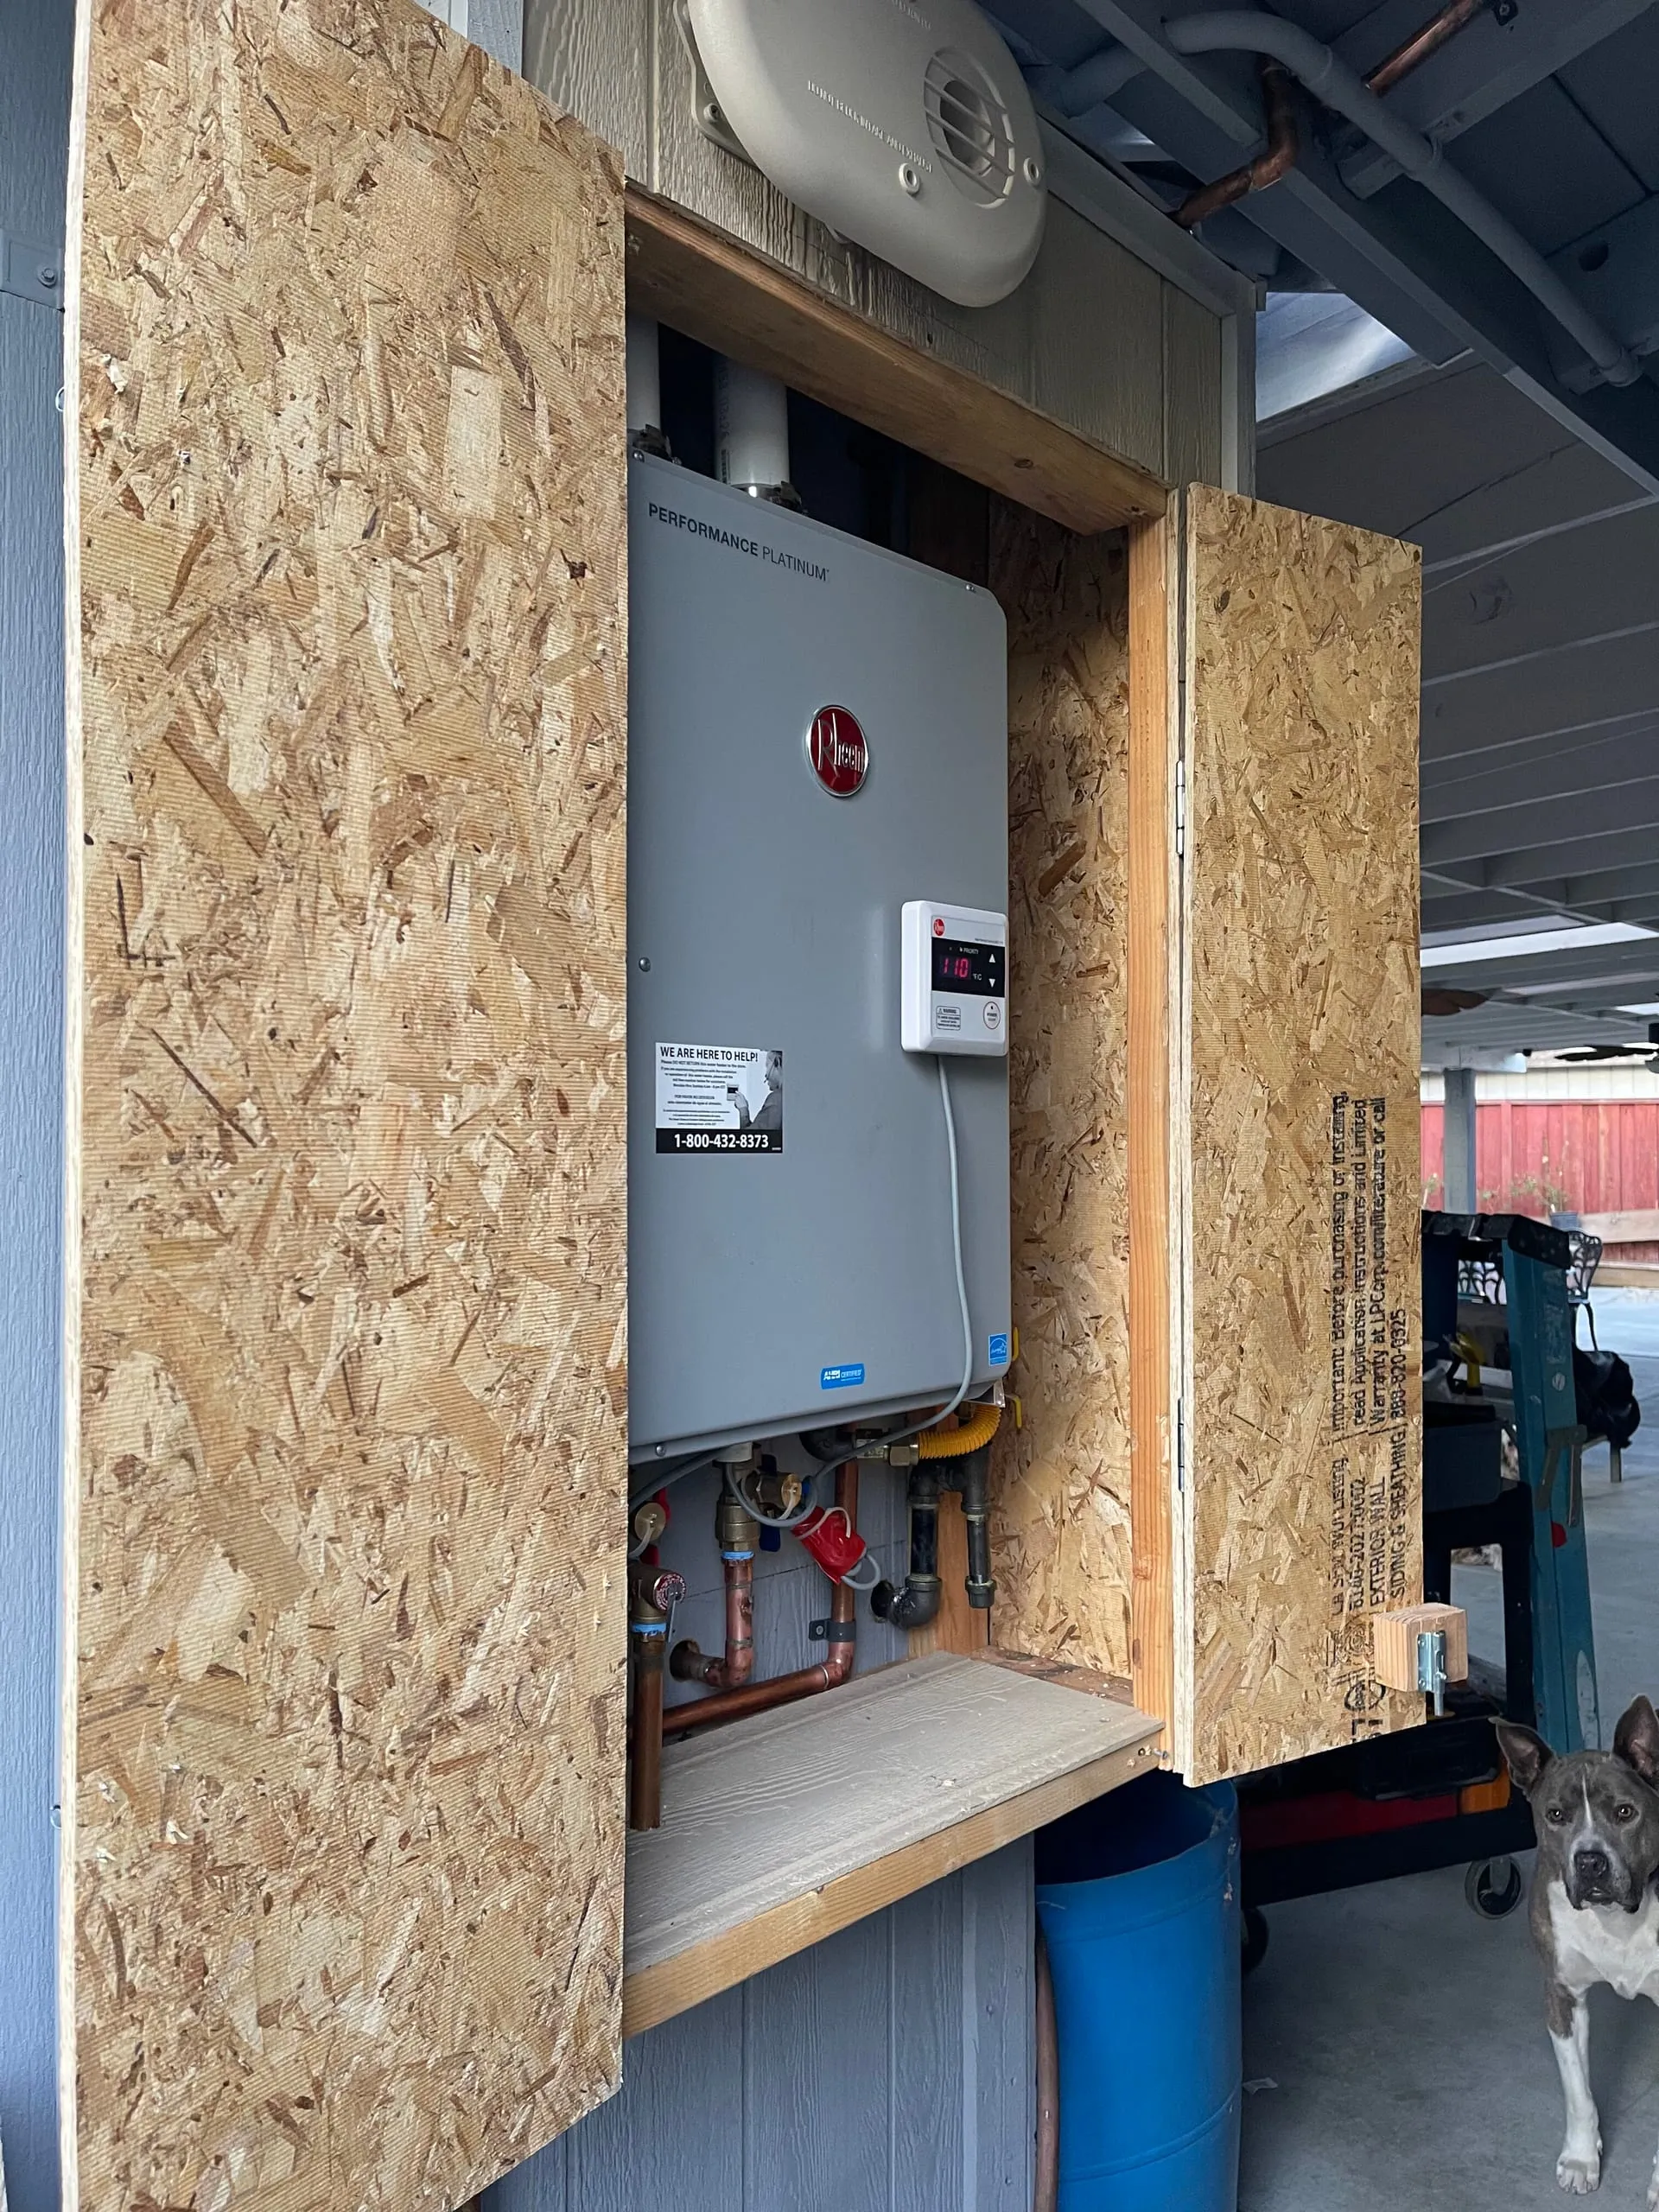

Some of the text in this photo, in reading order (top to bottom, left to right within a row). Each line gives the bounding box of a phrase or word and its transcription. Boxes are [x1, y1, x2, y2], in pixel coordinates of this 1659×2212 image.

[649, 502, 758, 556] PERFORMANCE
[944, 958, 969, 978] 110
[660, 1046, 758, 1062] WE ARE HERE TO HELP!
[1370, 1096, 1385, 1122] call
[675, 1134, 768, 1148] 1-800-432-8373
[1372, 1128, 1385, 1145] or
[1351, 1162, 1365, 1191] and
[1332, 1192, 1348, 1281] purchasing
[1331, 1286, 1344, 1342] Before
[1370, 1326, 1385, 1344] at
[1370, 1350, 1389, 1427] Warranty
[1350, 1389, 1365, 1427] read
[1389, 1428, 1405, 1520] SHEATHING
[1369, 1476, 1385, 1607] EXTERIOR WALL
[1389, 1541, 1406, 1599] SIDING
